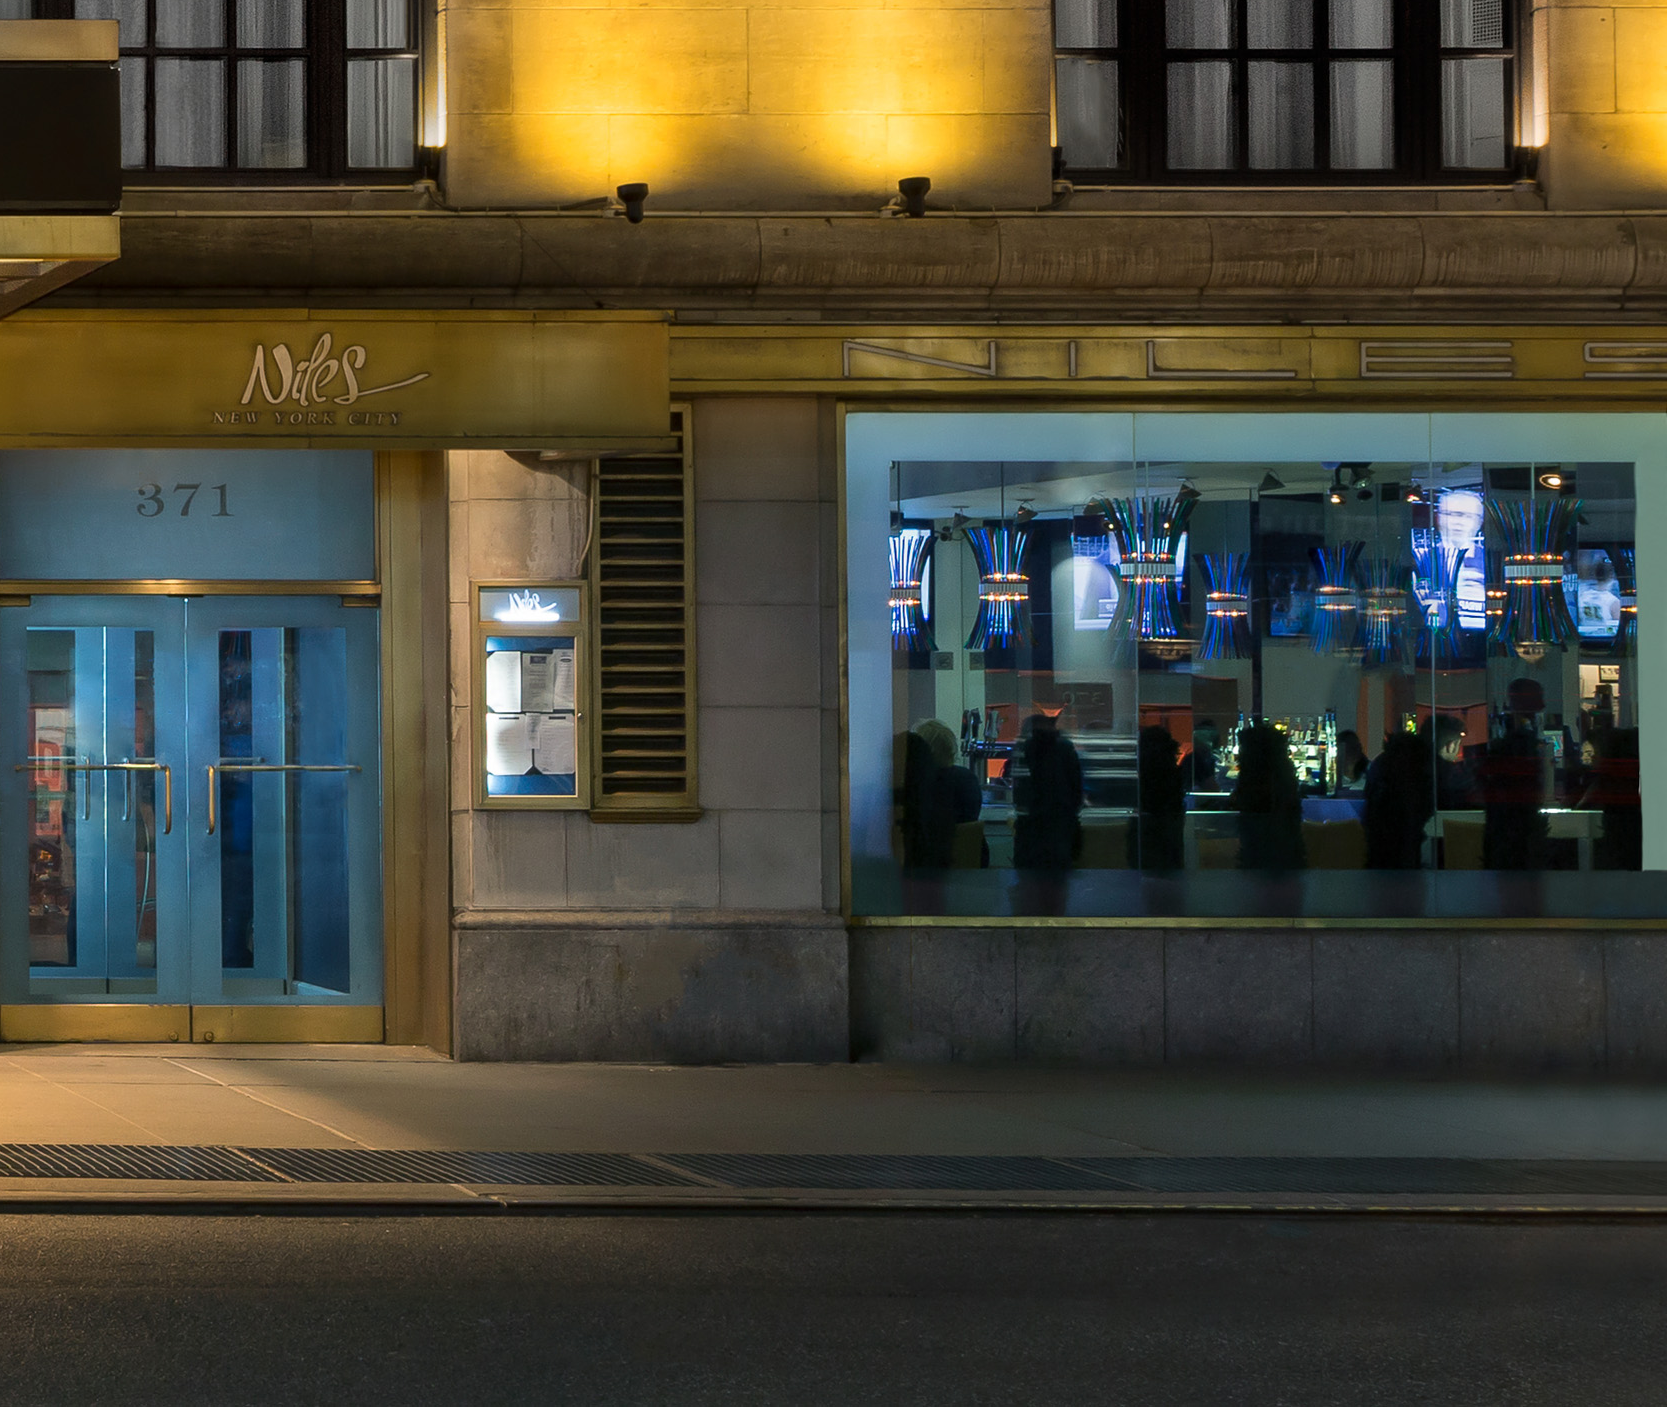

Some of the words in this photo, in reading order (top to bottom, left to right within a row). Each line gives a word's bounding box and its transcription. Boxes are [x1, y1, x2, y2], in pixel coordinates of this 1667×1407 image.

[241, 333, 431, 407] Niles
[213, 411, 260, 425] NEW
[274, 411, 336, 425] YORK
[348, 411, 403, 426] CITY
[136, 482, 235, 517] 371
